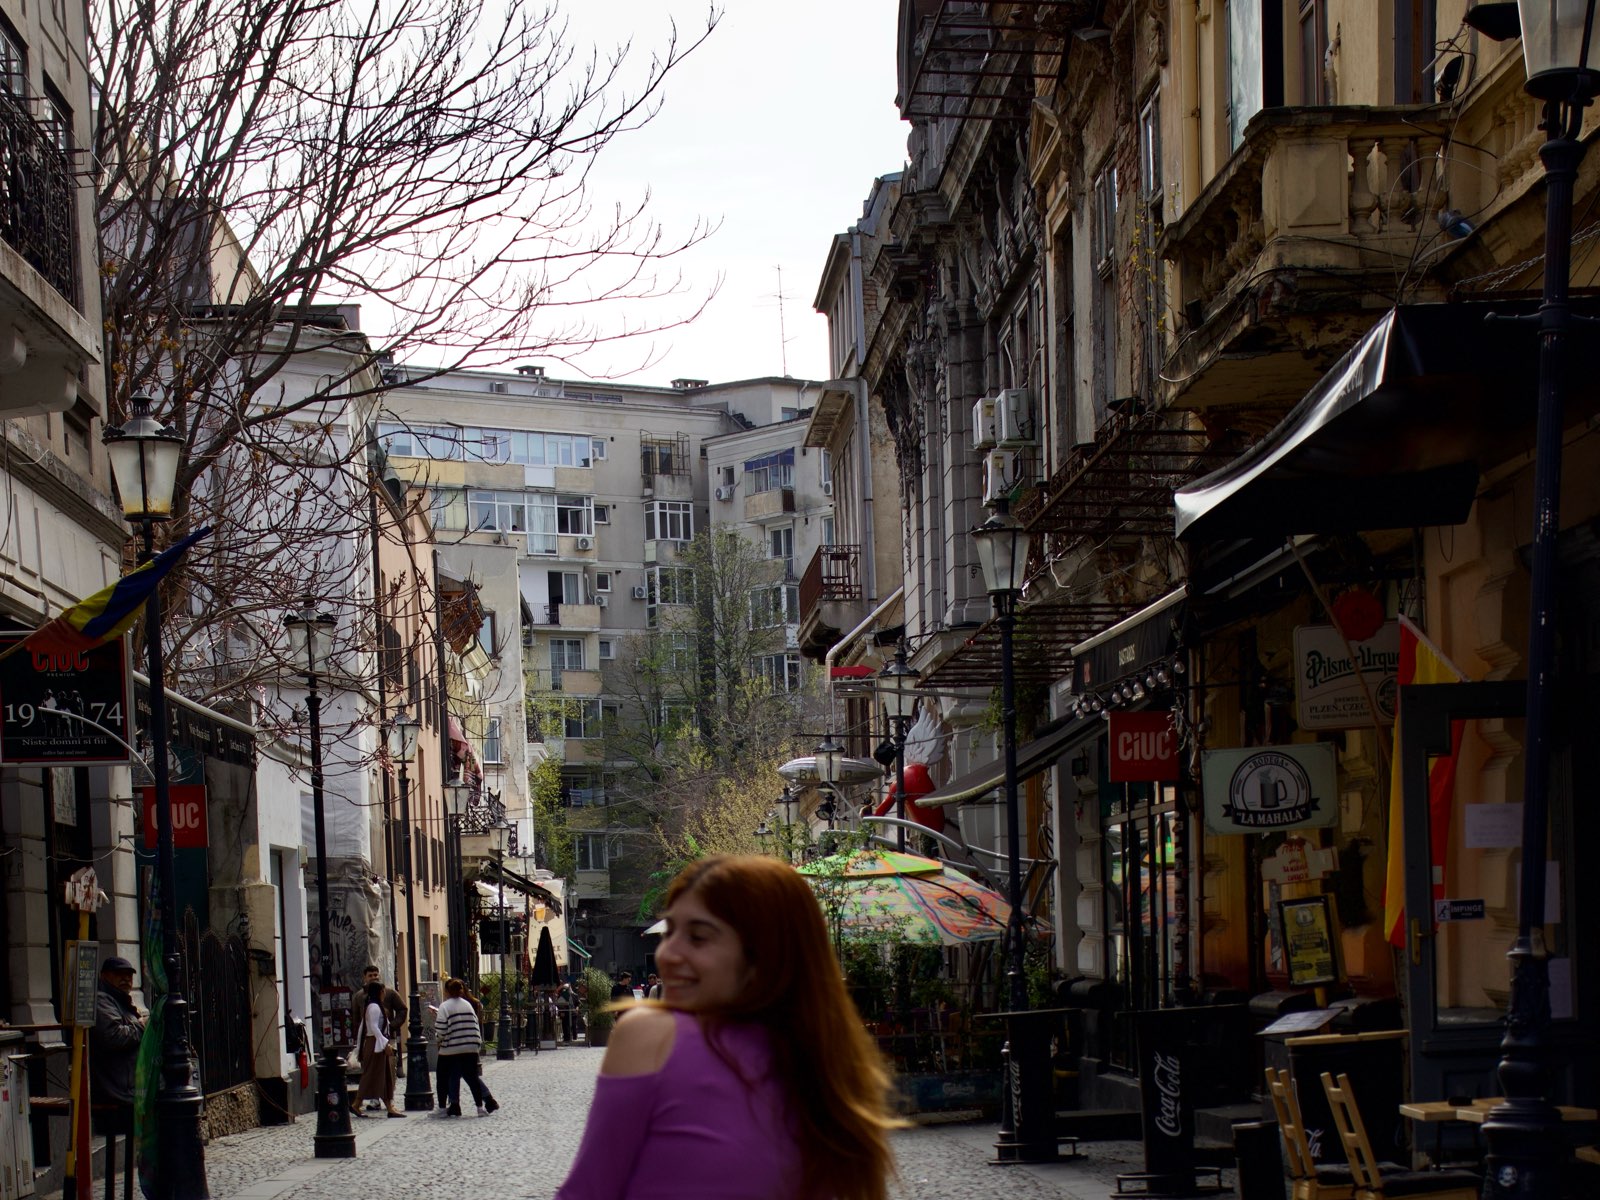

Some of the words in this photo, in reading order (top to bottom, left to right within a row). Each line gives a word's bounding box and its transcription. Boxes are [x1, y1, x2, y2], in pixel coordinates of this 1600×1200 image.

[1359, 645, 1401, 675] Urqu
[4, 703, 36, 728] 19
[90, 701, 124, 727] 74
[1343, 702, 1370, 711] CZEC
[1252, 756, 1285, 767] BODEGA
